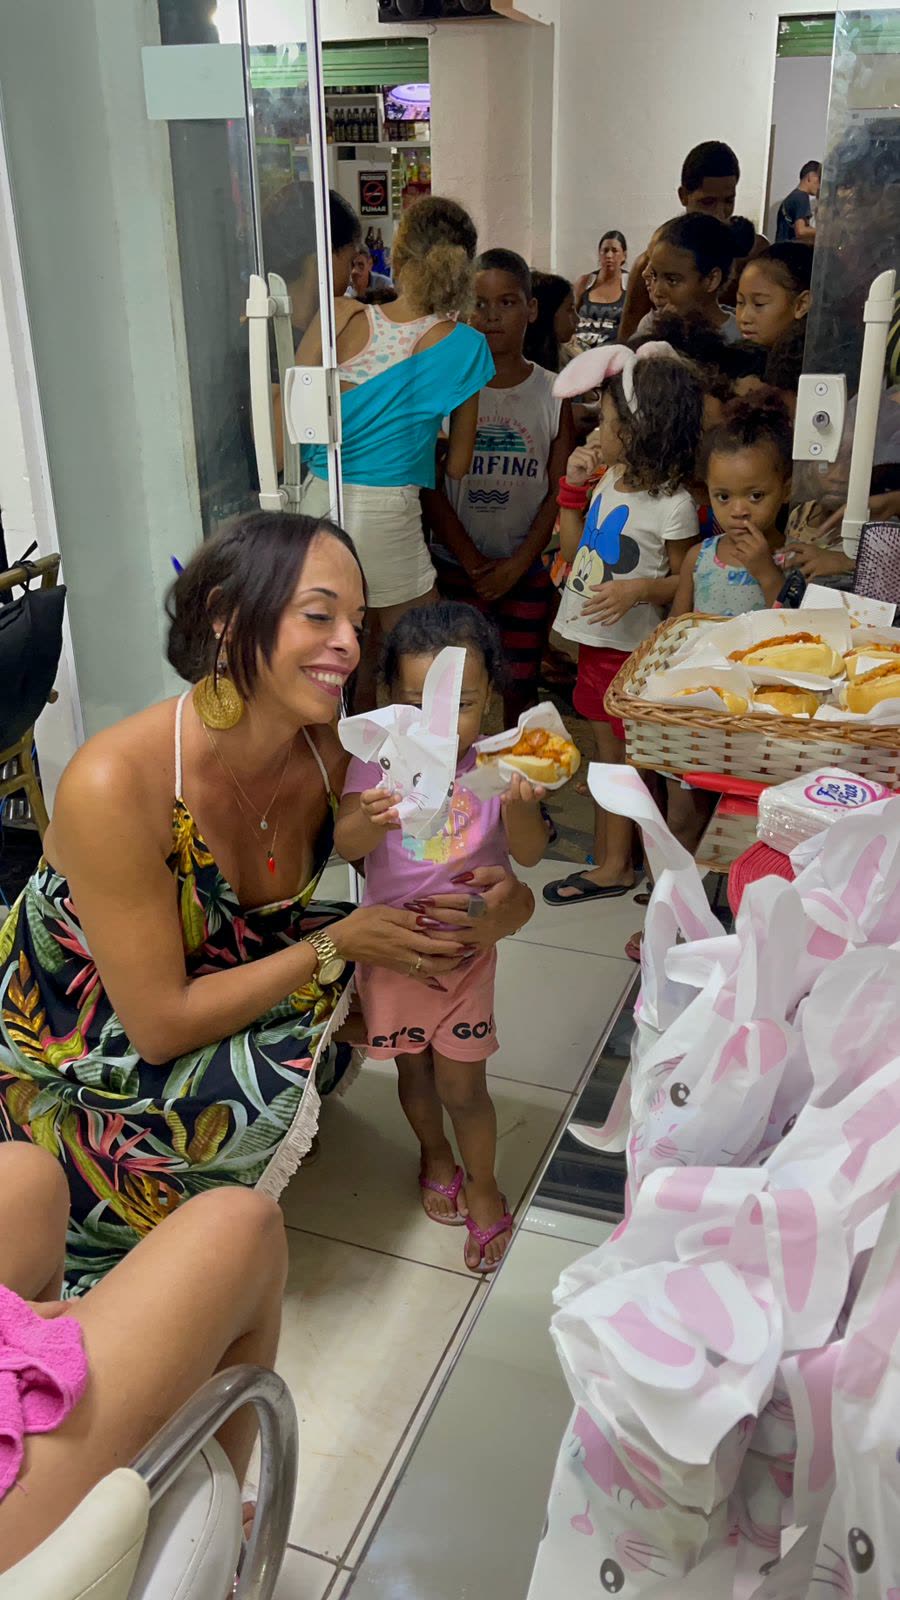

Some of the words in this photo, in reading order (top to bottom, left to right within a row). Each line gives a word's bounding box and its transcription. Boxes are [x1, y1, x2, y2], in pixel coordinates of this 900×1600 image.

[472, 455, 539, 479] RFING
[371, 1026, 426, 1048] ET'S
[452, 1013, 493, 1040] GO!
